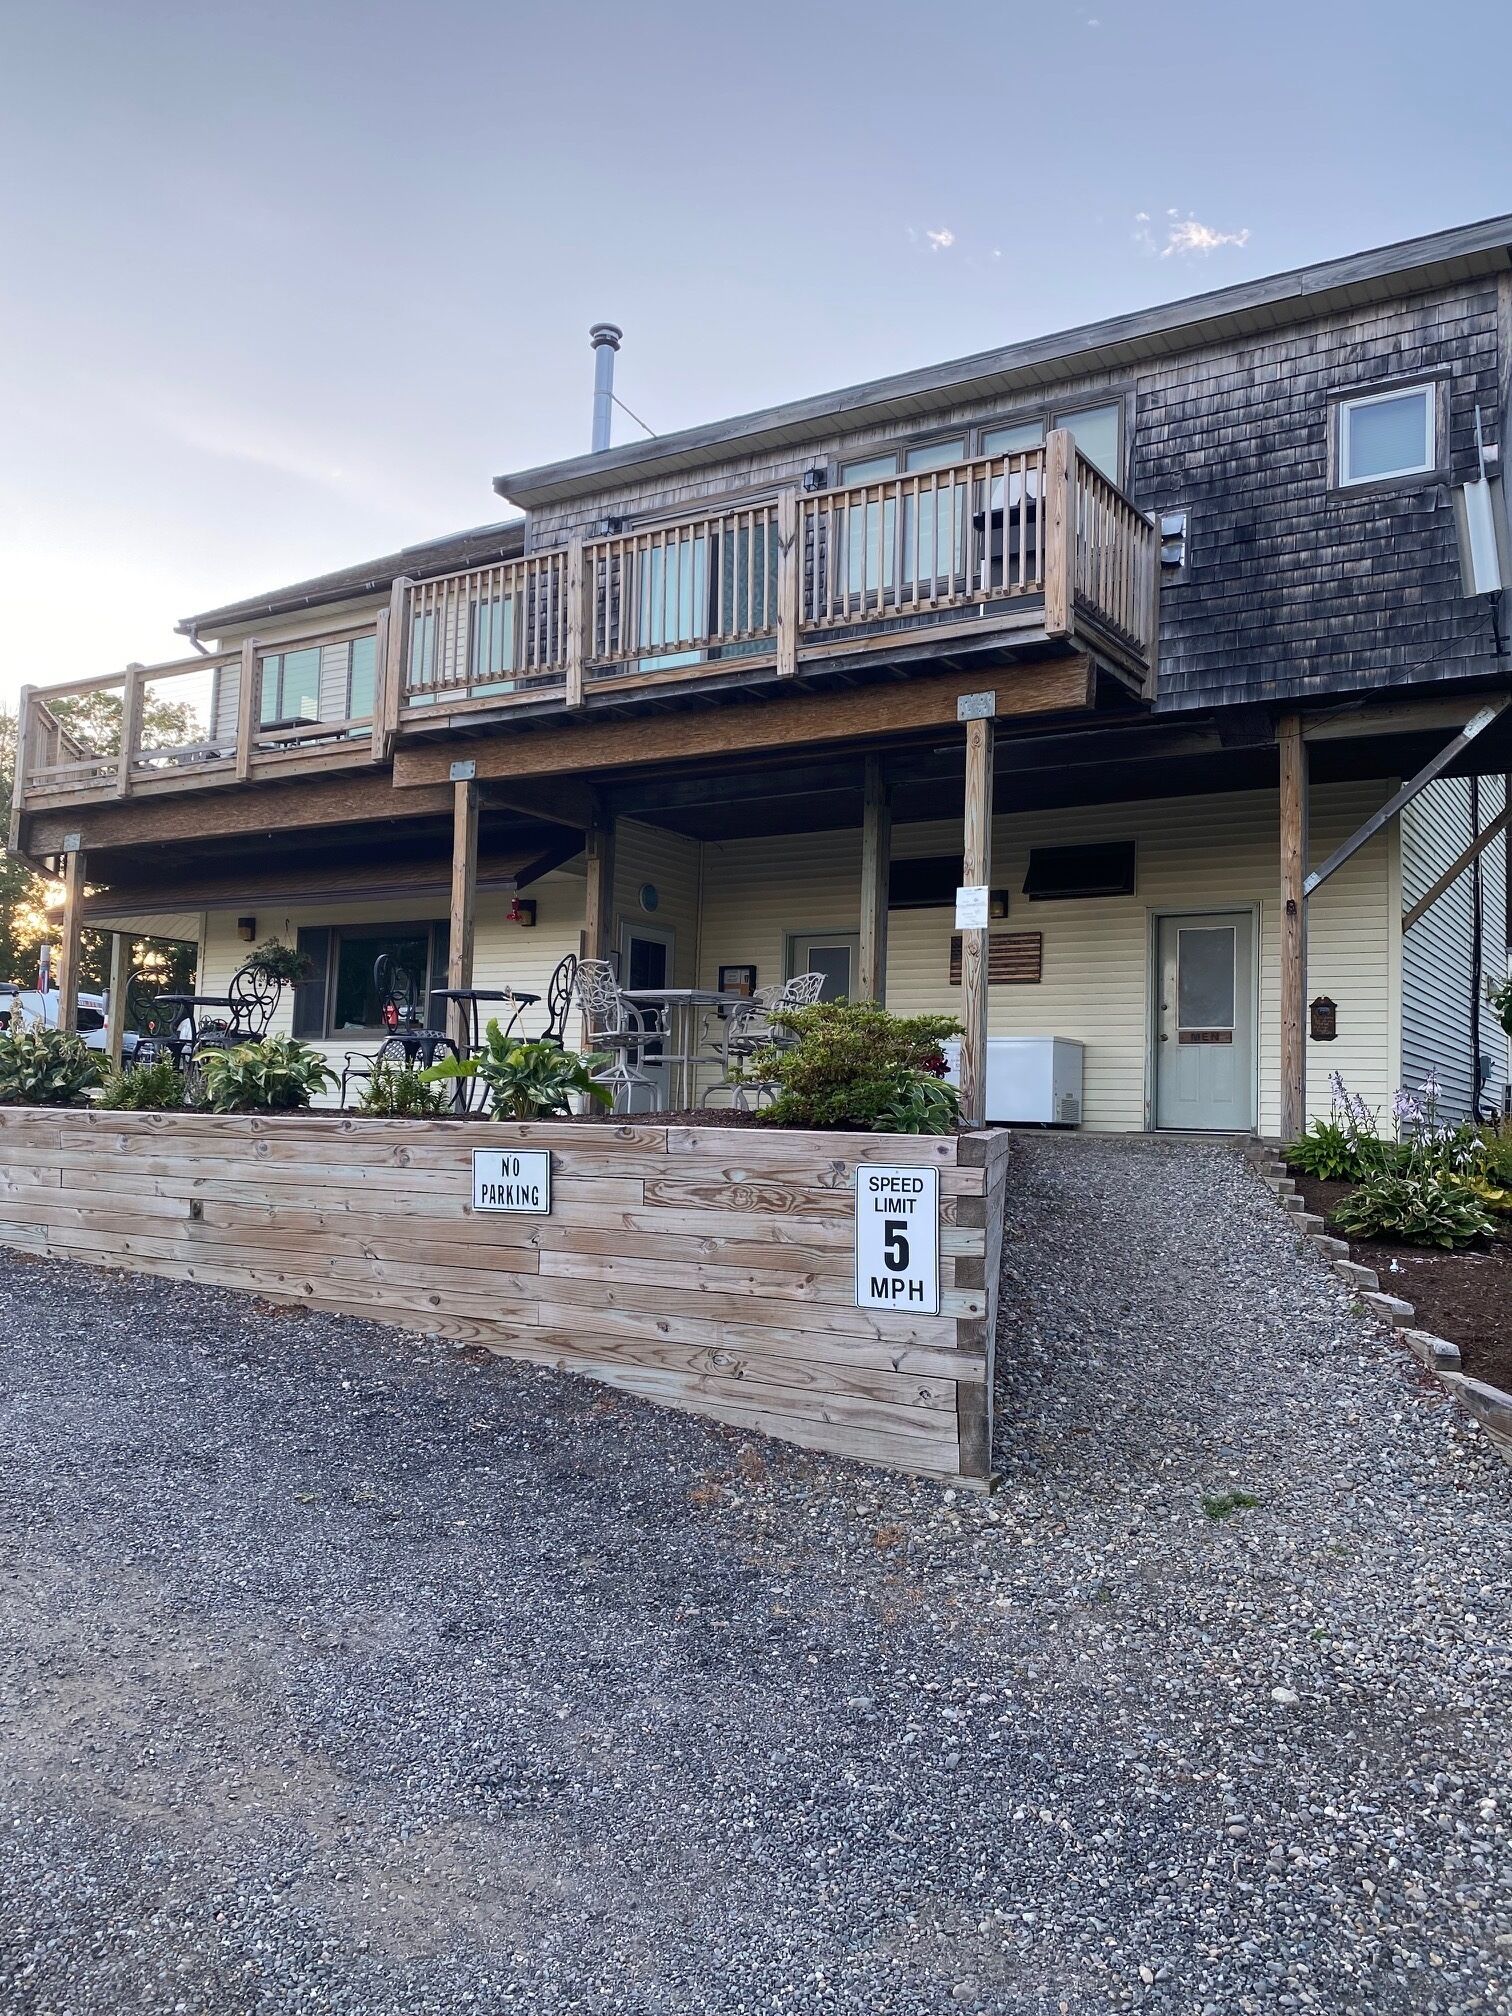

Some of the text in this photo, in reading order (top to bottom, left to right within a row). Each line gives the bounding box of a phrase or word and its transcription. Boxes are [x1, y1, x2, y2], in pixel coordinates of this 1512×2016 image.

[1190, 1032, 1219, 1041] MEN
[501, 1157, 520, 1177] NO
[869, 1176, 924, 1193] SPEED
[481, 1184, 539, 1206] PARKING
[874, 1197, 917, 1214] LIMIT
[884, 1219, 910, 1272] 5
[870, 1276, 924, 1302] MPH
